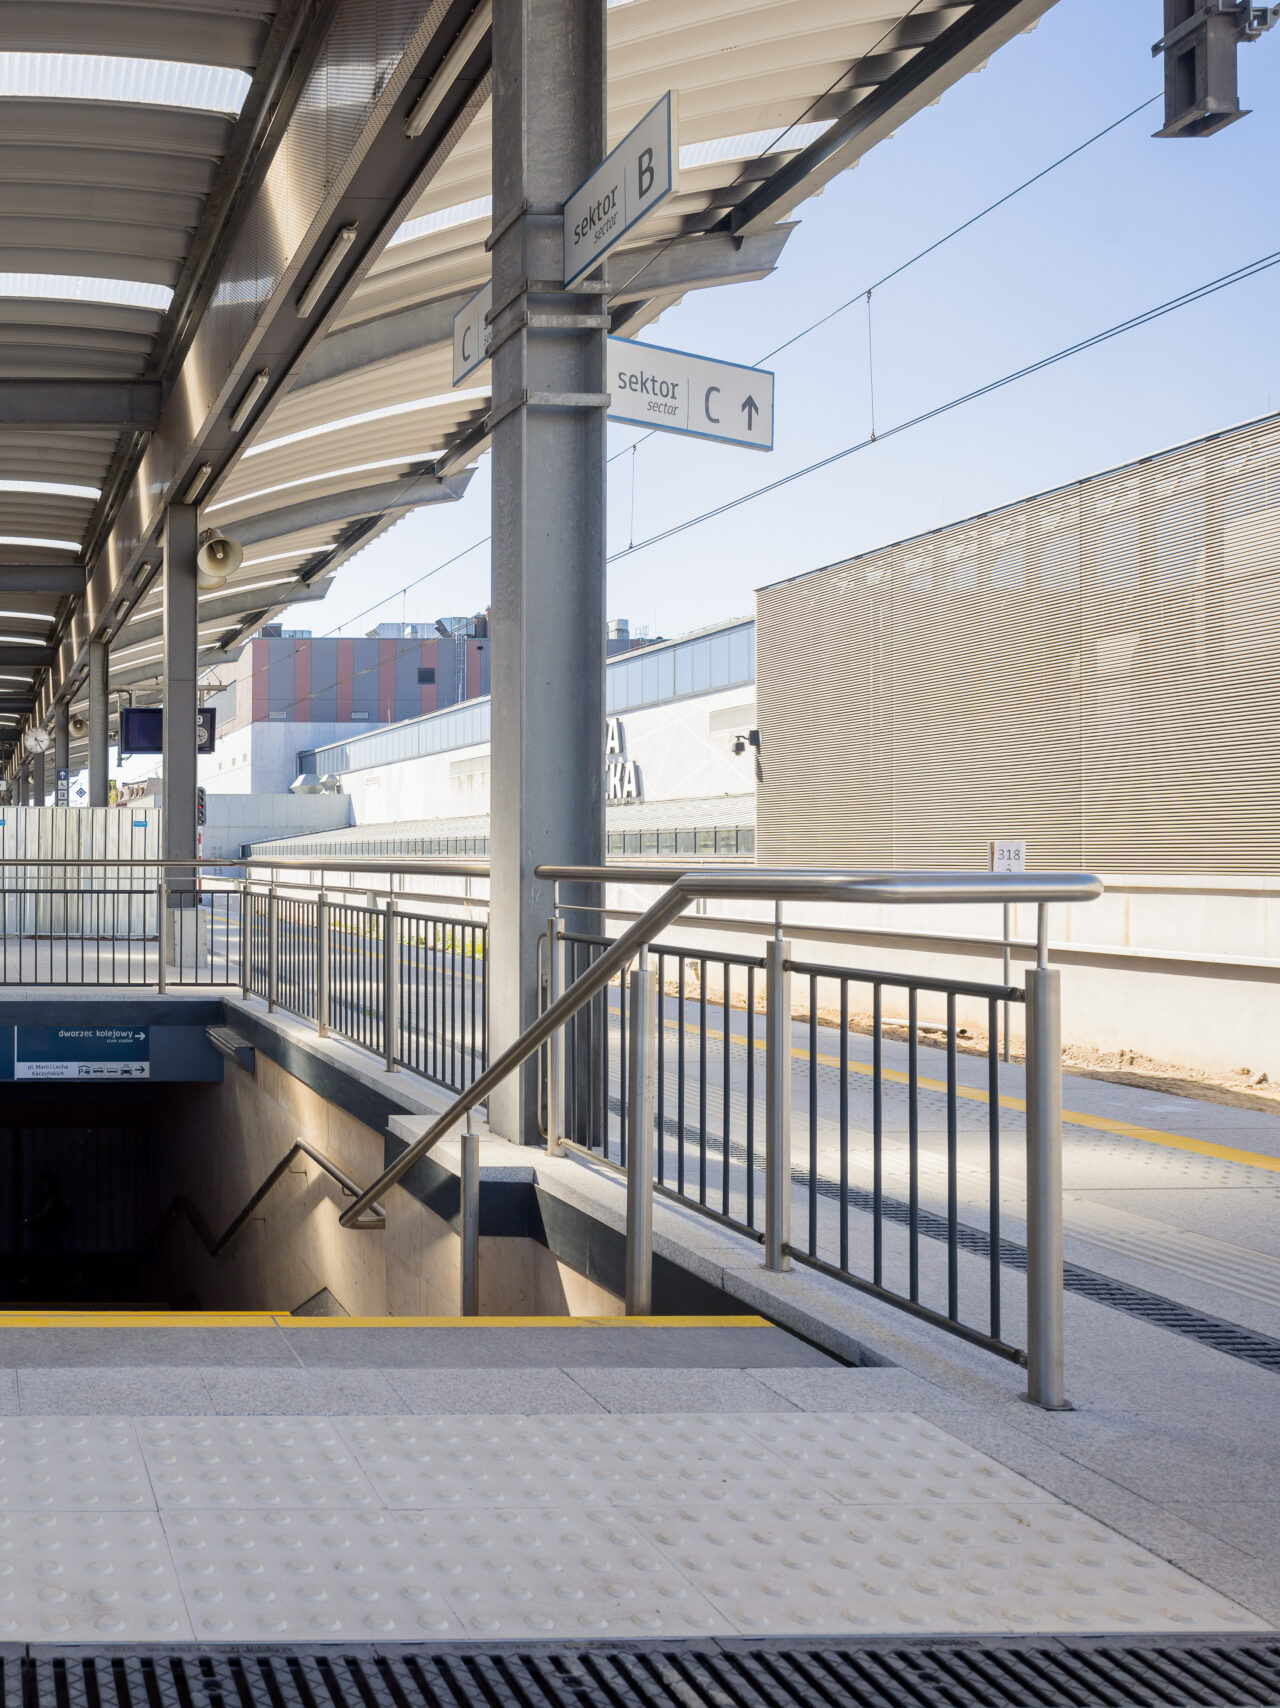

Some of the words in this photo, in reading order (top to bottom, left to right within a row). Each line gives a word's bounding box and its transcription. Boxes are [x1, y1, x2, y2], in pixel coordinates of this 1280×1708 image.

[574, 185, 618, 246] sektor
[638, 147, 654, 200] B
[593, 211, 618, 244] sector
[462, 324, 471, 362] C
[618, 371, 679, 400] sektor
[704, 386, 721, 424] C
[646, 400, 679, 416] sector
[606, 760, 641, 799] KA
[998, 849, 1021, 860] 318
[59, 1029, 93, 1037] dworzec
[96, 1029, 133, 1039] kolejowy
